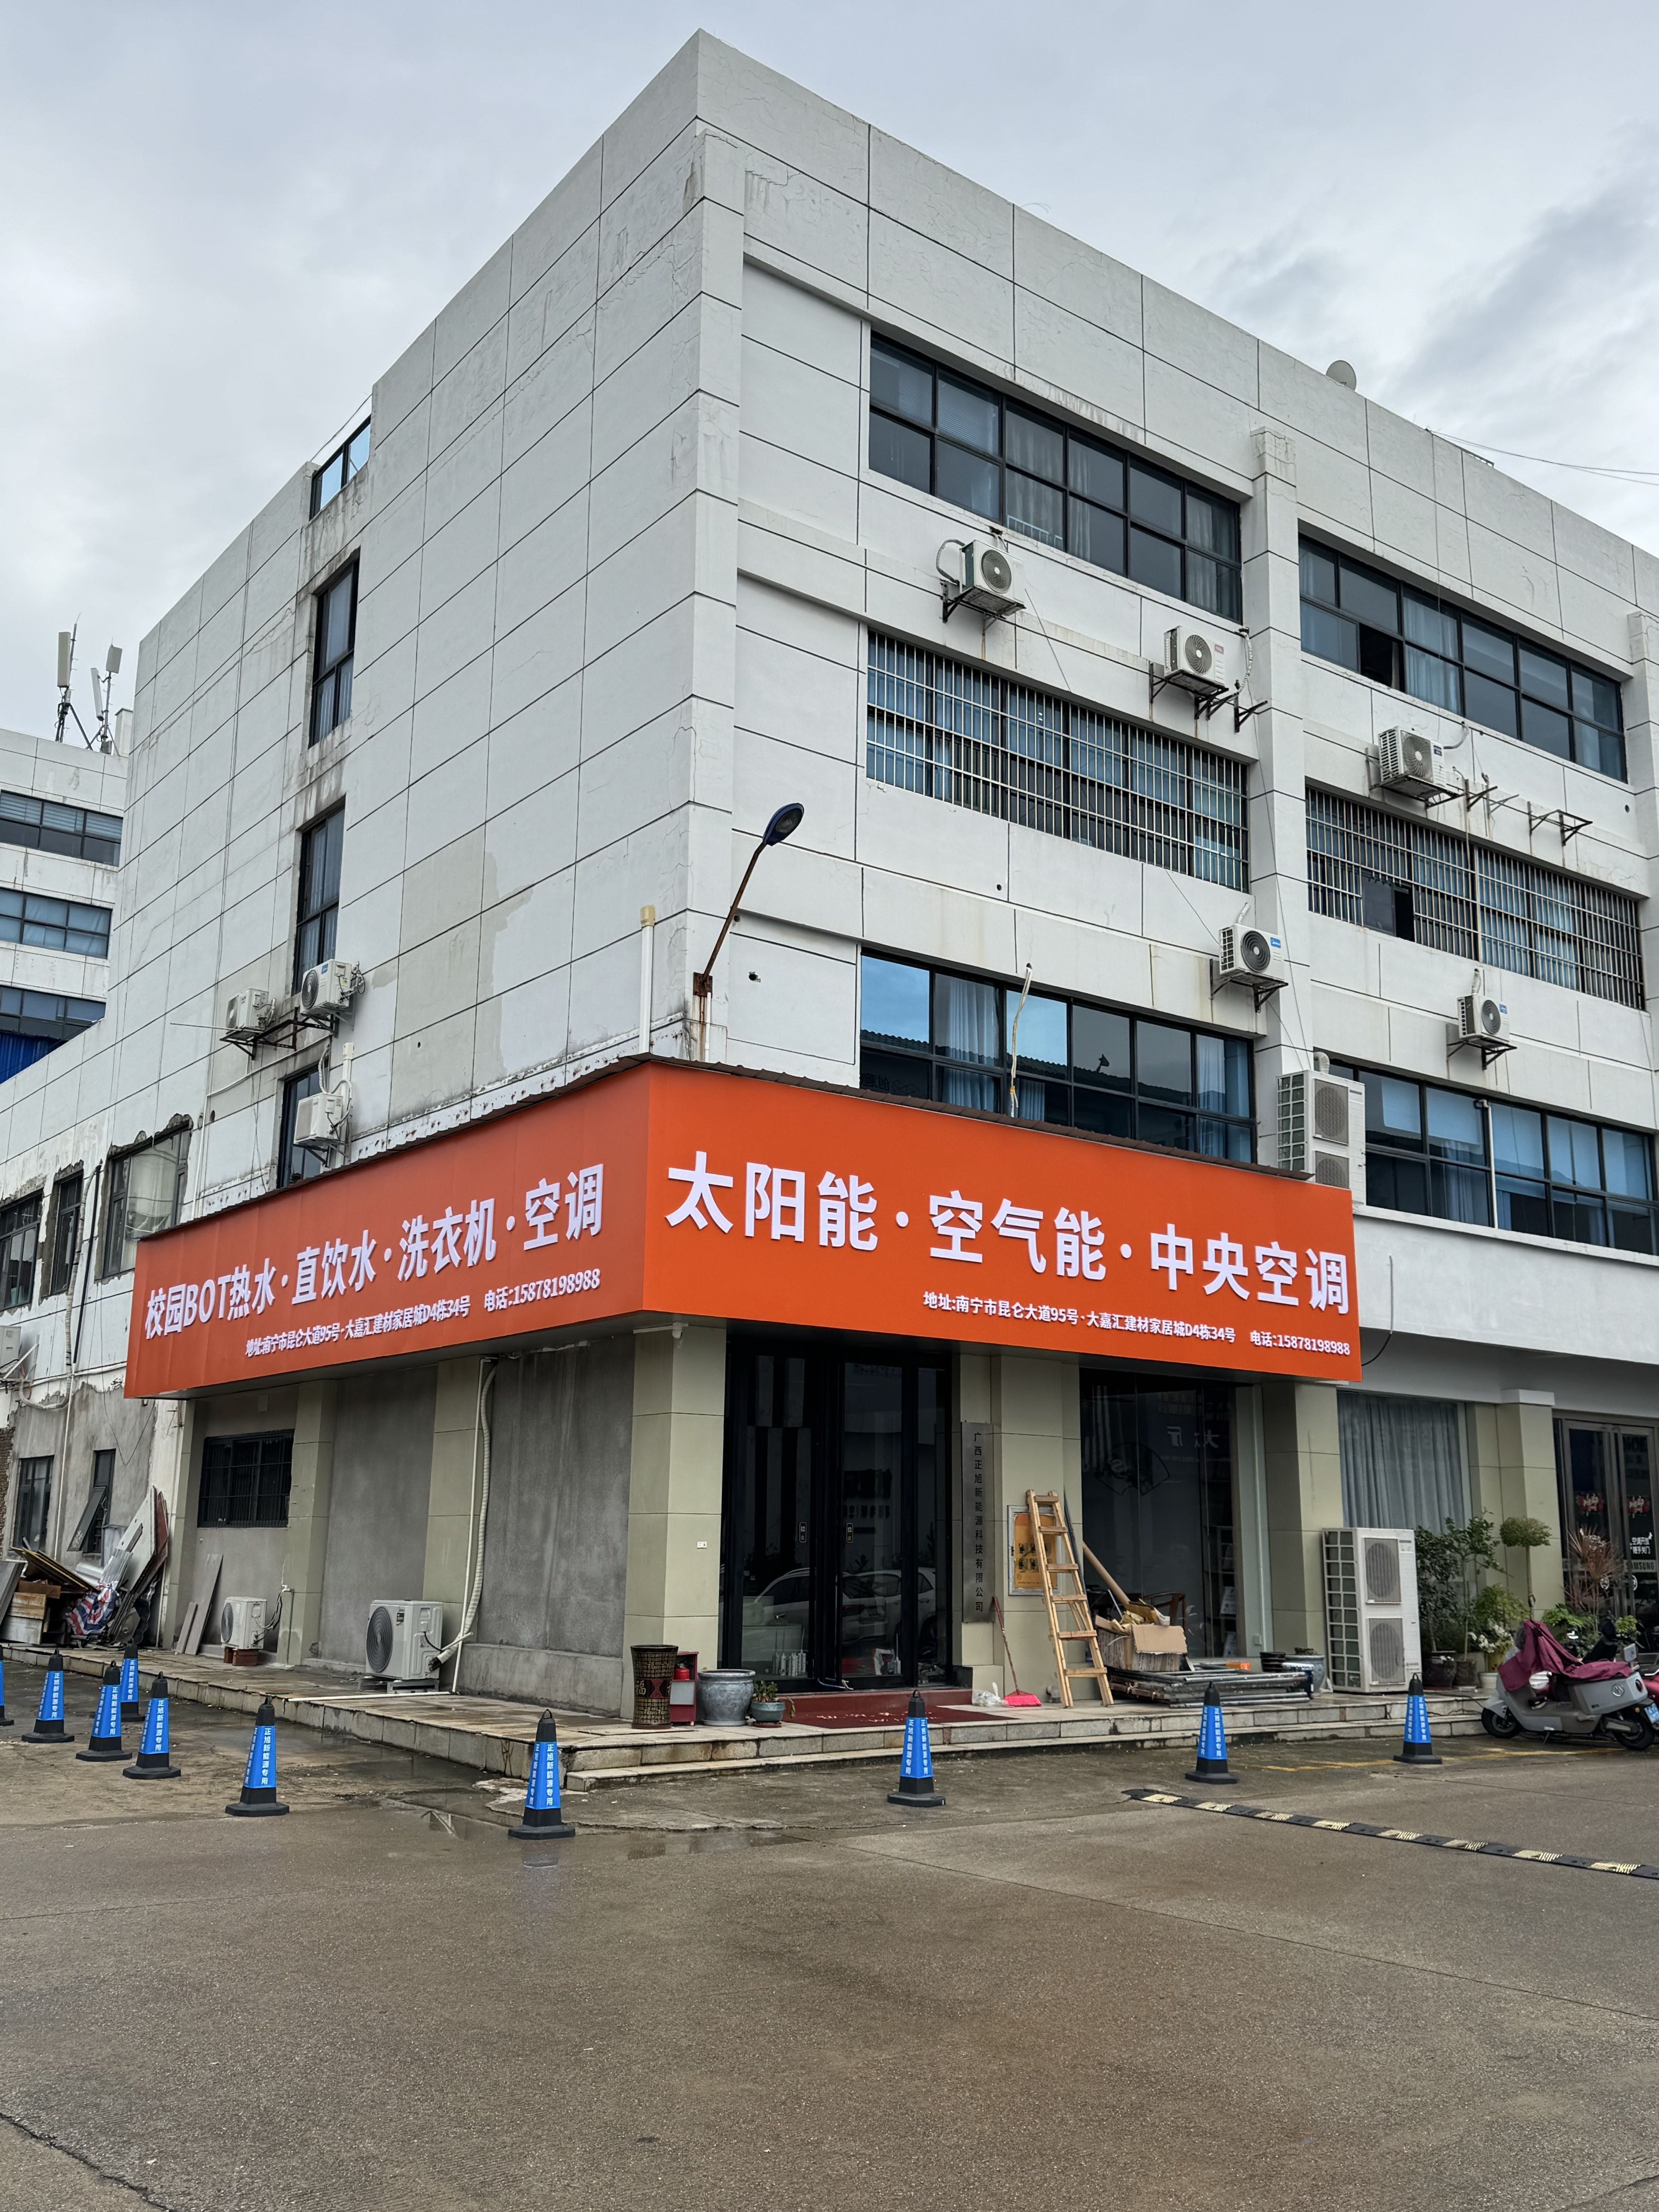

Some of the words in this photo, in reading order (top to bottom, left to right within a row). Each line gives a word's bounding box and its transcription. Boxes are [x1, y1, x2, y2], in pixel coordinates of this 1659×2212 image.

[665, 1151, 1349, 1314] 太阳能·空气能·中央空调
[974, 1432, 983, 1612] 广西正旭新能源科技有限公司
[635, 1680, 647, 1696] 福
[261, 1728, 272, 1785] 正旭新能源专用
